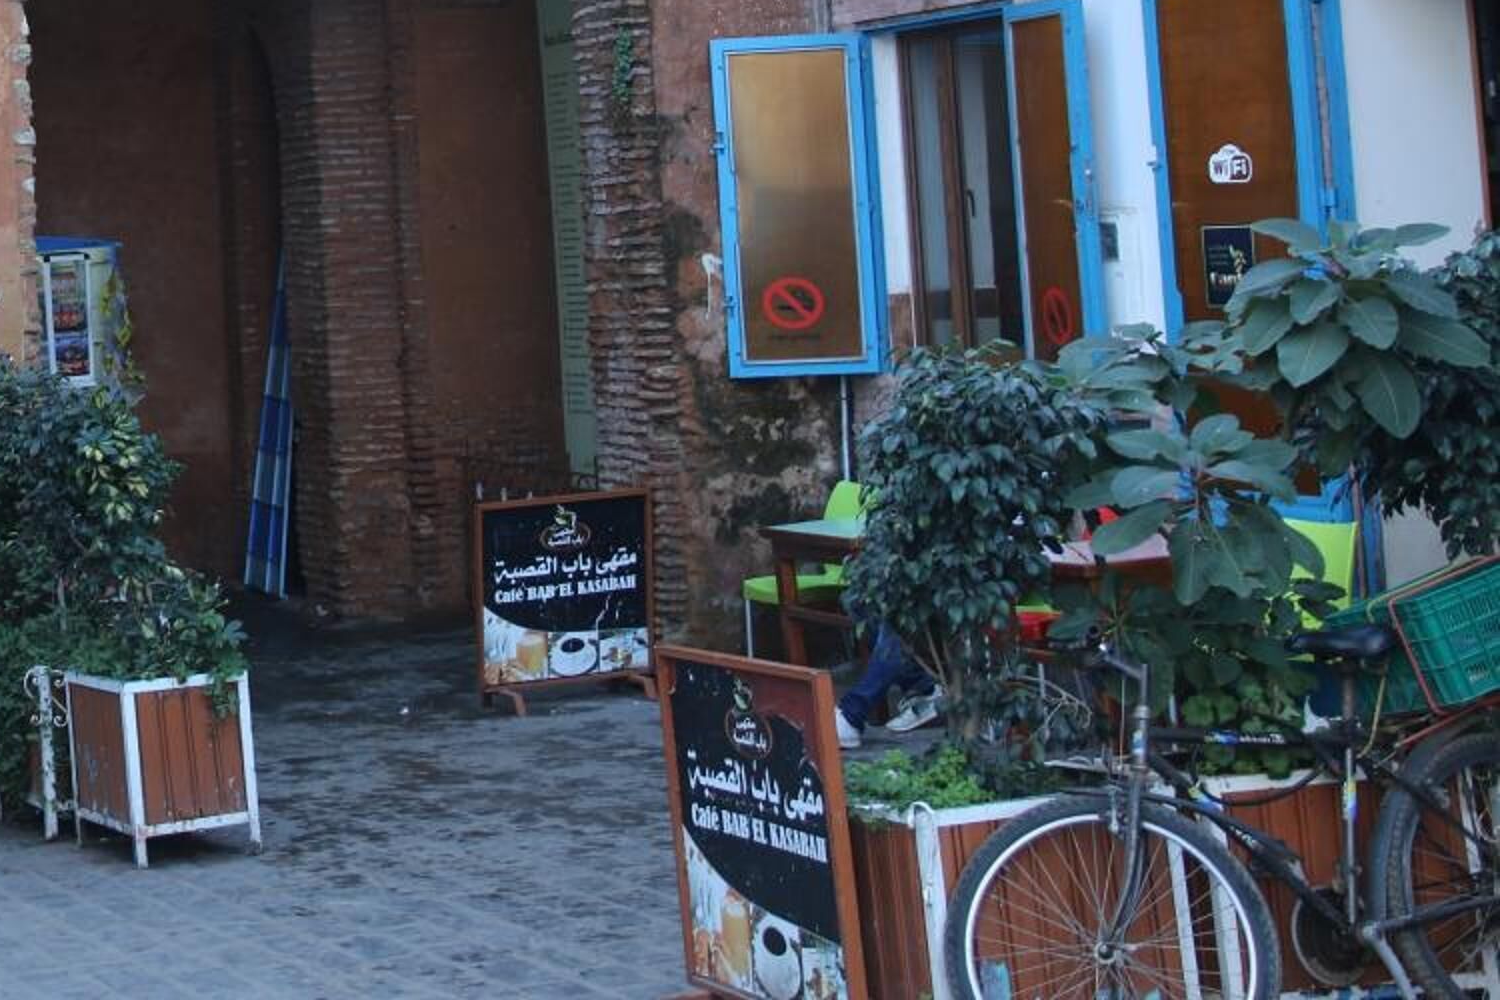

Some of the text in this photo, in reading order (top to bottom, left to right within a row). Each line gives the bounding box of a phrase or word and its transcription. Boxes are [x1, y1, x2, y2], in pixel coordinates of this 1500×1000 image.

[494, 547, 637, 585] مقهى باب القصبة
[495, 574, 636, 604] Café BAB EL KASABAH
[687, 749, 823, 820] مقهى باب القصبة
[691, 802, 827, 863] Café BAB EL KASABAH
